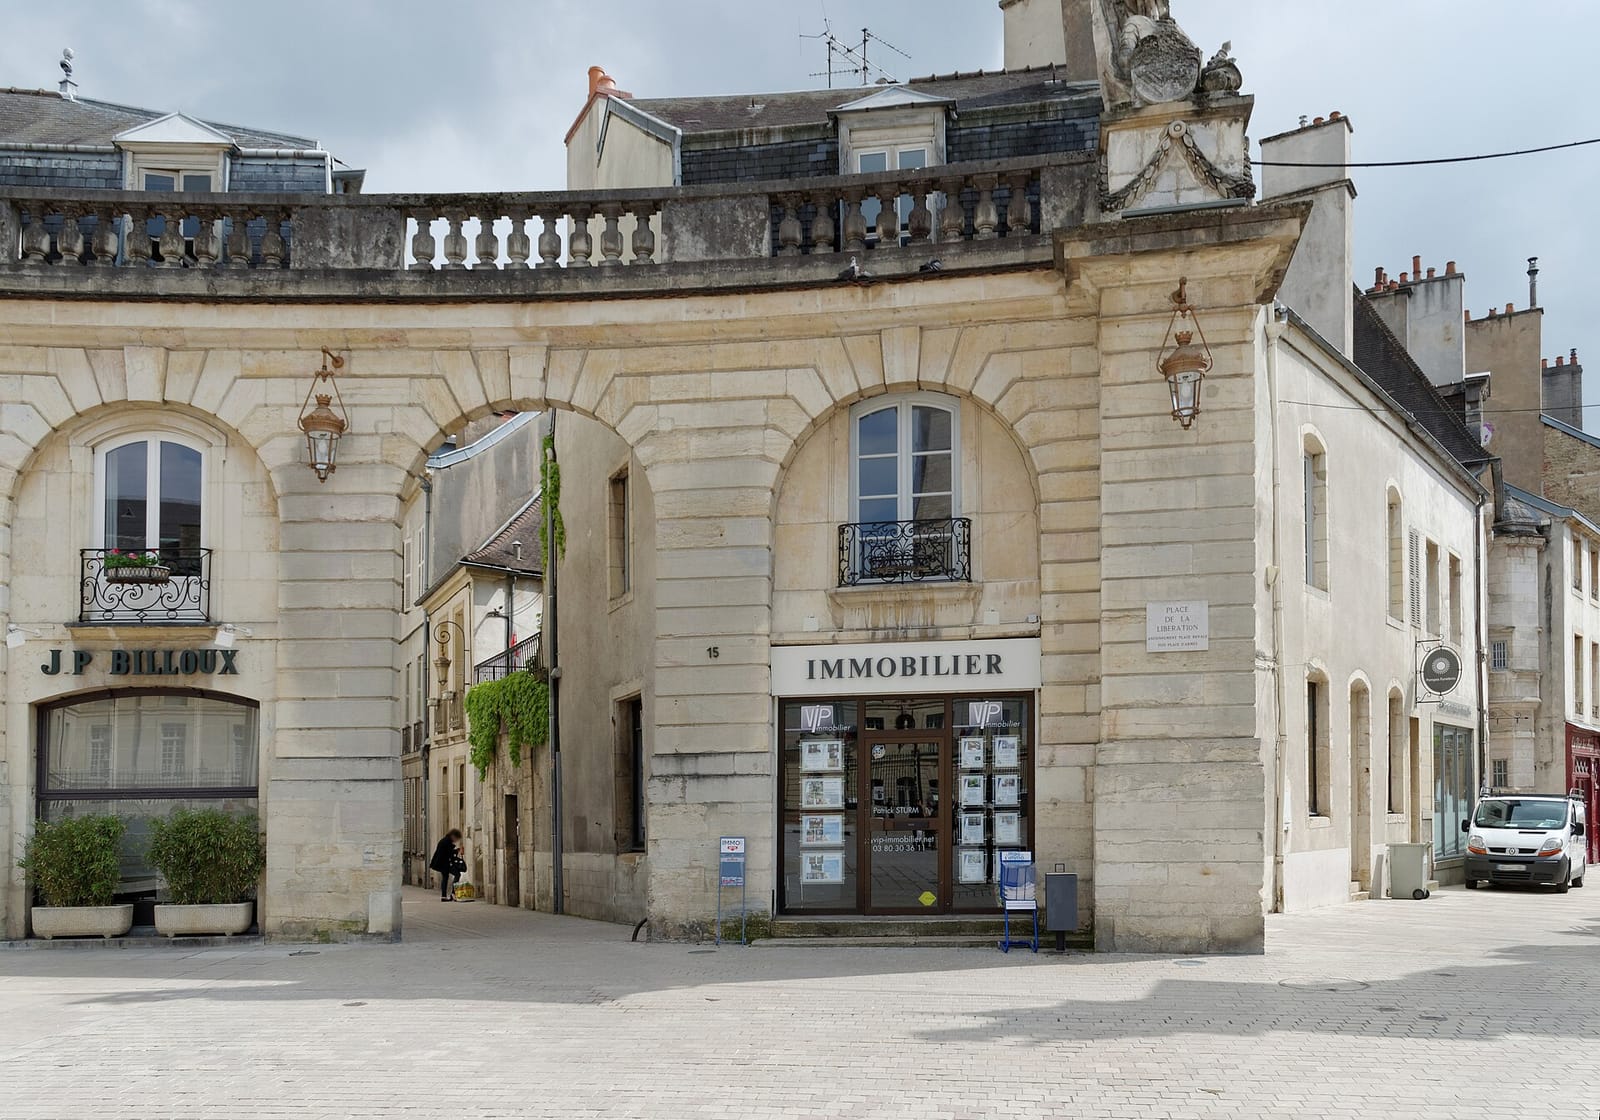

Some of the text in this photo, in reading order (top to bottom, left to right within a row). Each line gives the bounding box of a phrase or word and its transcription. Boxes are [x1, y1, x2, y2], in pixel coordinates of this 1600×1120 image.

[1166, 606, 1189, 614] PLACE
[1164, 615, 1175, 623] DE
[706, 647, 720, 658] 15
[109, 649, 240, 675] BILLOUX
[806, 653, 1004, 680] IMMOBILIER
[873, 806, 920, 814] Patrick STURM
[872, 844, 882, 852] 03
